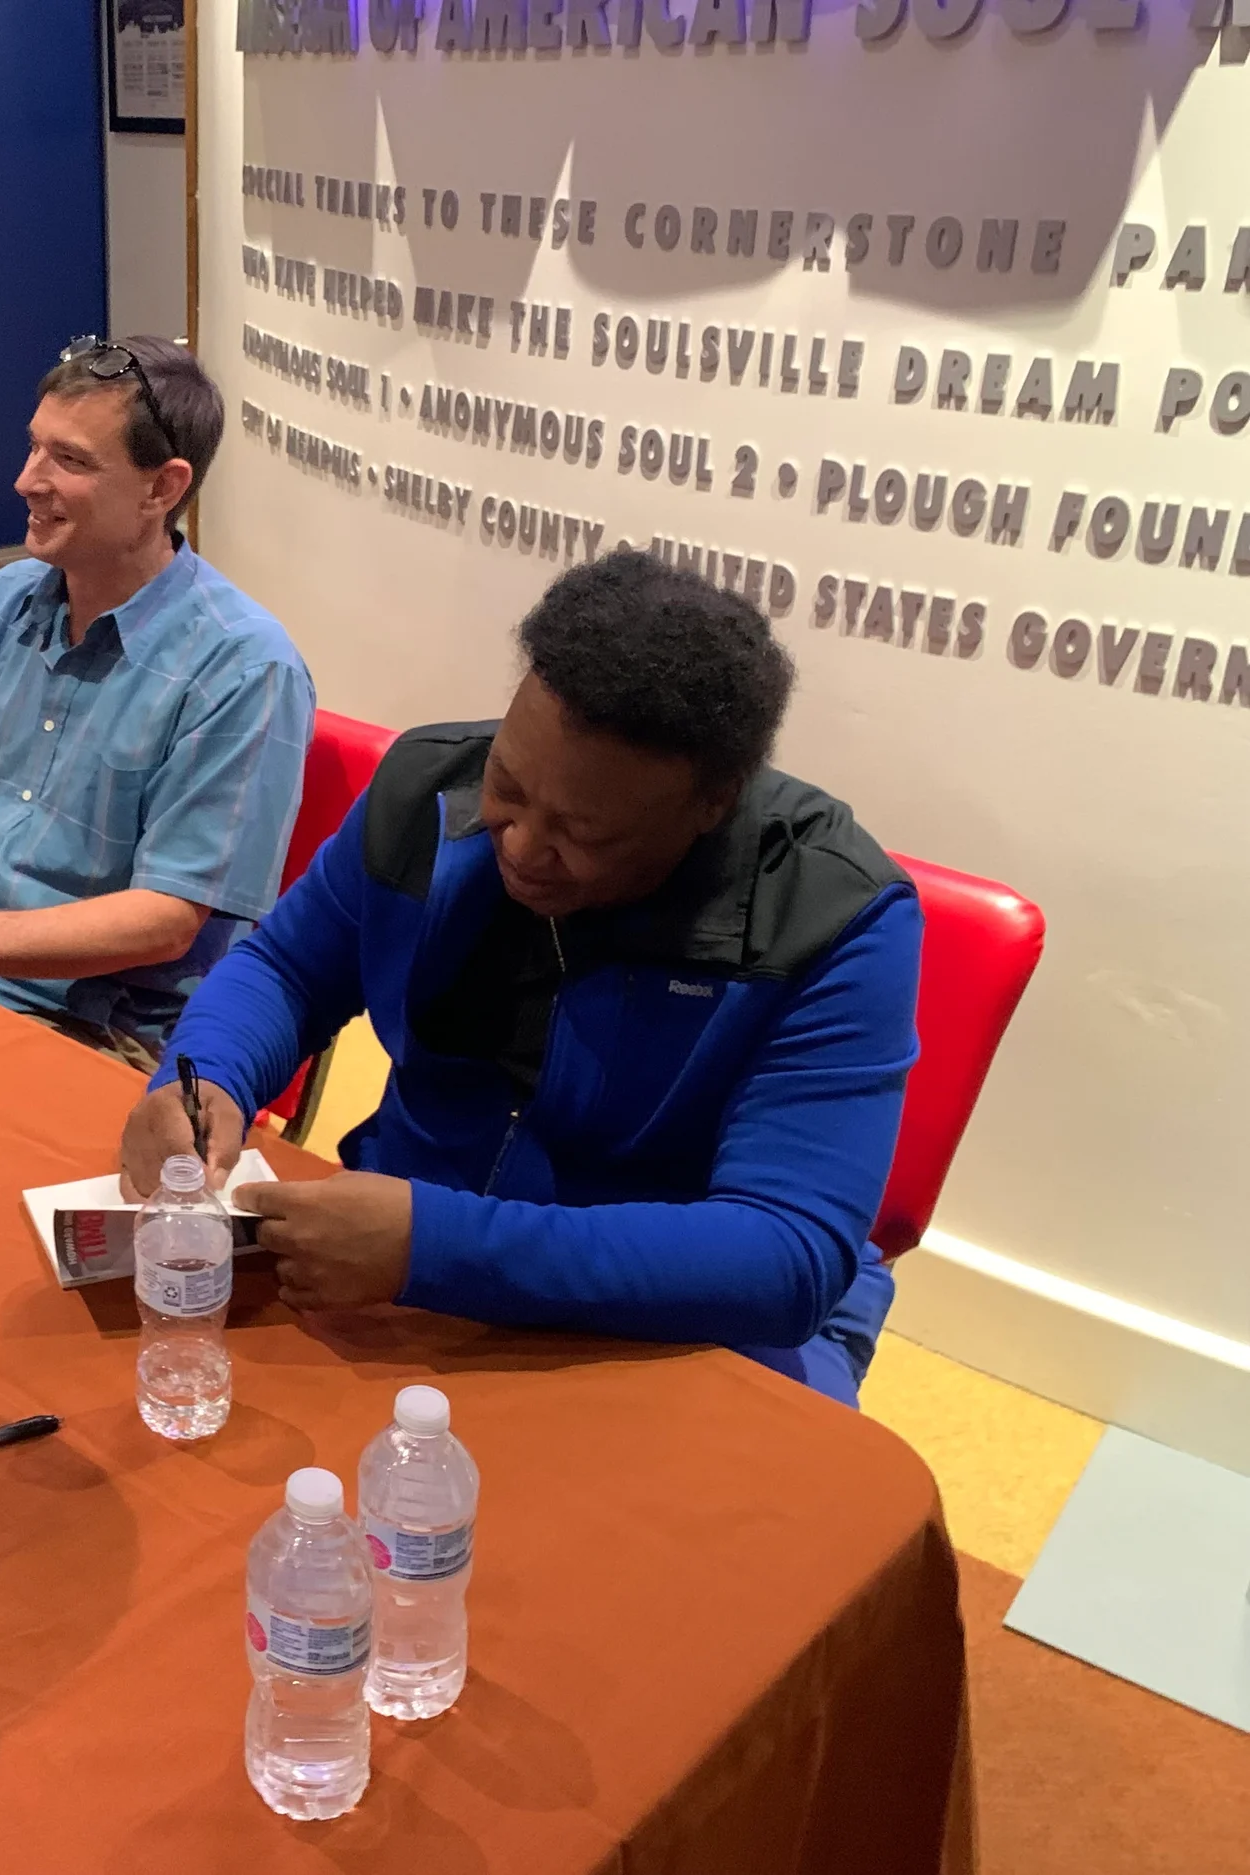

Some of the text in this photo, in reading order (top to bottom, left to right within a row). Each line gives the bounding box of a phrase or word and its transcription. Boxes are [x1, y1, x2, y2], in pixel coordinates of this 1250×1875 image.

[314, 174, 406, 226] THANKS
[422, 188, 459, 231] TO
[480, 192, 597, 250] THESE
[625, 202, 1066, 273] CORNERSTONE
[275, 256, 316, 302] HAVE
[323, 268, 403, 322] HELPED
[413, 287, 494, 339] MAKE
[510, 301, 572, 354] THE
[593, 313, 864, 396] SOULSVILLE
[893, 345, 1120, 425] DREAM
[326, 357, 370, 405] SOUL
[380, 374, 391, 412] 1
[419, 384, 604, 462] ANONYMOUS
[618, 424, 713, 486] SOUL
[731, 445, 758, 497] 2
[816, 459, 1030, 546] PLOUGH
[286, 425, 361, 487] MEMPHIS
[384, 465, 472, 525] SHELBY
[481, 497, 604, 563] COUNTY
[814, 575, 986, 660] STATES
[64, 1227, 77, 1265] HOWARD
